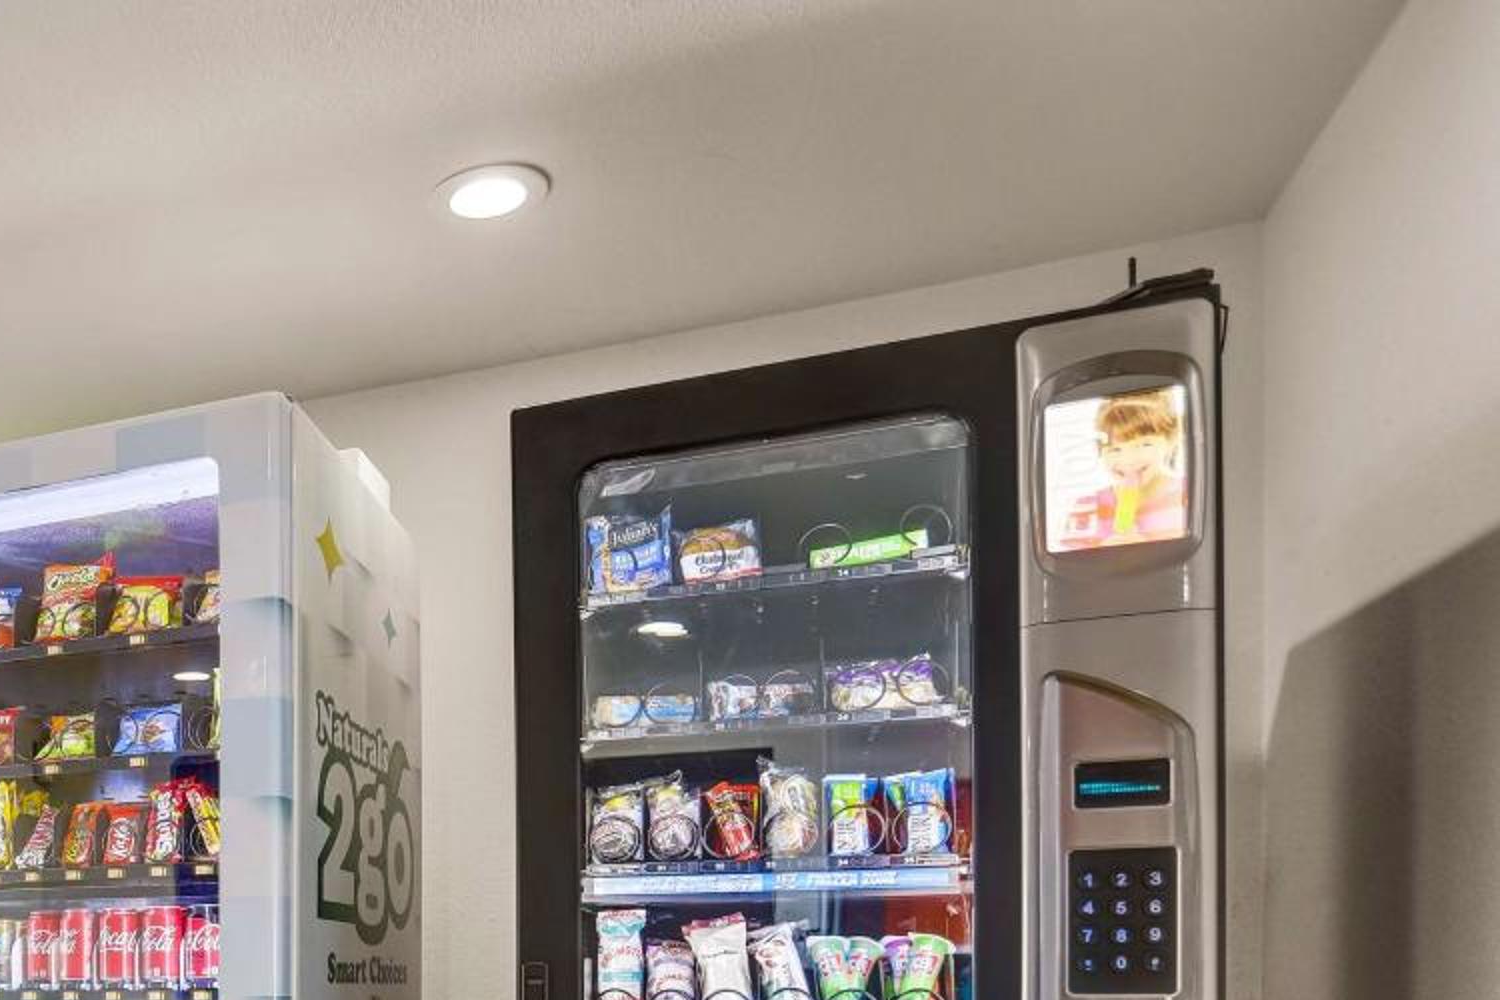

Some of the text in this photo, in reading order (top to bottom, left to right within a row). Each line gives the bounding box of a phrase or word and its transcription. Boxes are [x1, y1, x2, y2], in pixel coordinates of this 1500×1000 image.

[315, 688, 390, 775] Naturals
[1082, 871, 1162, 888] 1 2 3
[1082, 899, 1162, 915] 4 5 6
[1082, 927, 1161, 943] 7 8 9
[326, 951, 367, 986] Smart
[1115, 955, 1127, 970] 0
